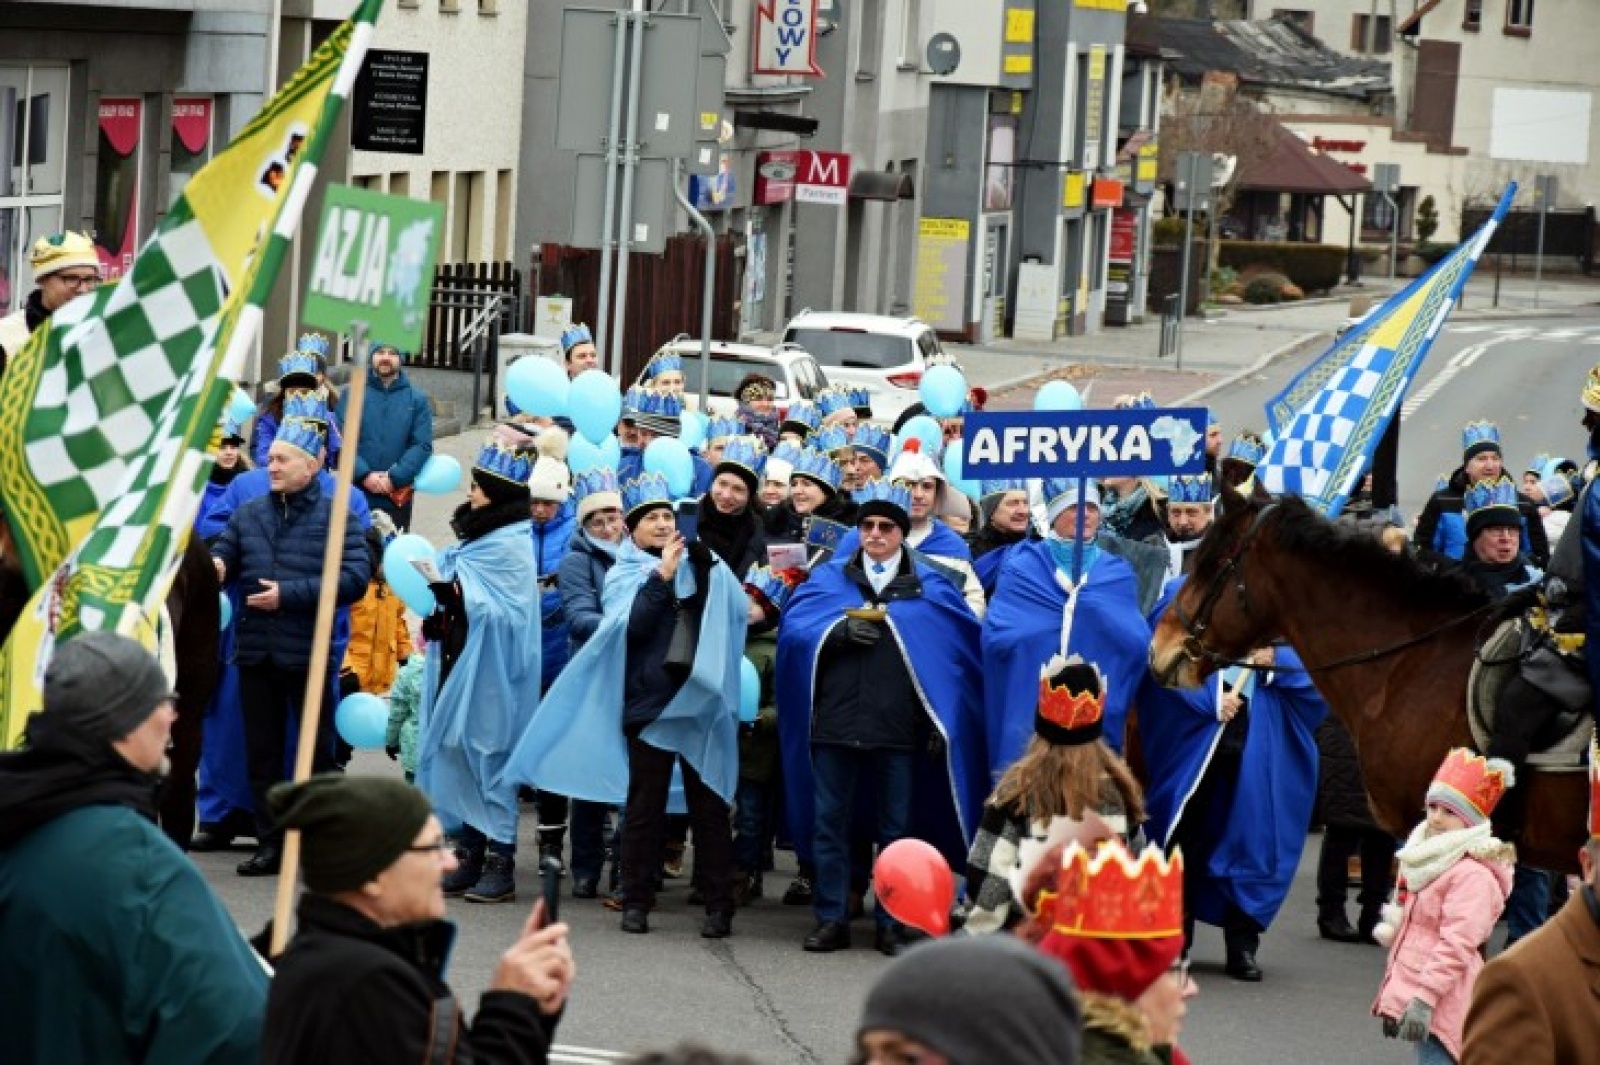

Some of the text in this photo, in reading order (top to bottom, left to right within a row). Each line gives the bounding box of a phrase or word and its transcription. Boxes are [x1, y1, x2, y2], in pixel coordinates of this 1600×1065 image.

[775, 0, 805, 66] OWY
[808, 150, 840, 185] M
[310, 206, 391, 307] AZJA
[968, 424, 1151, 465] AFRYKA
